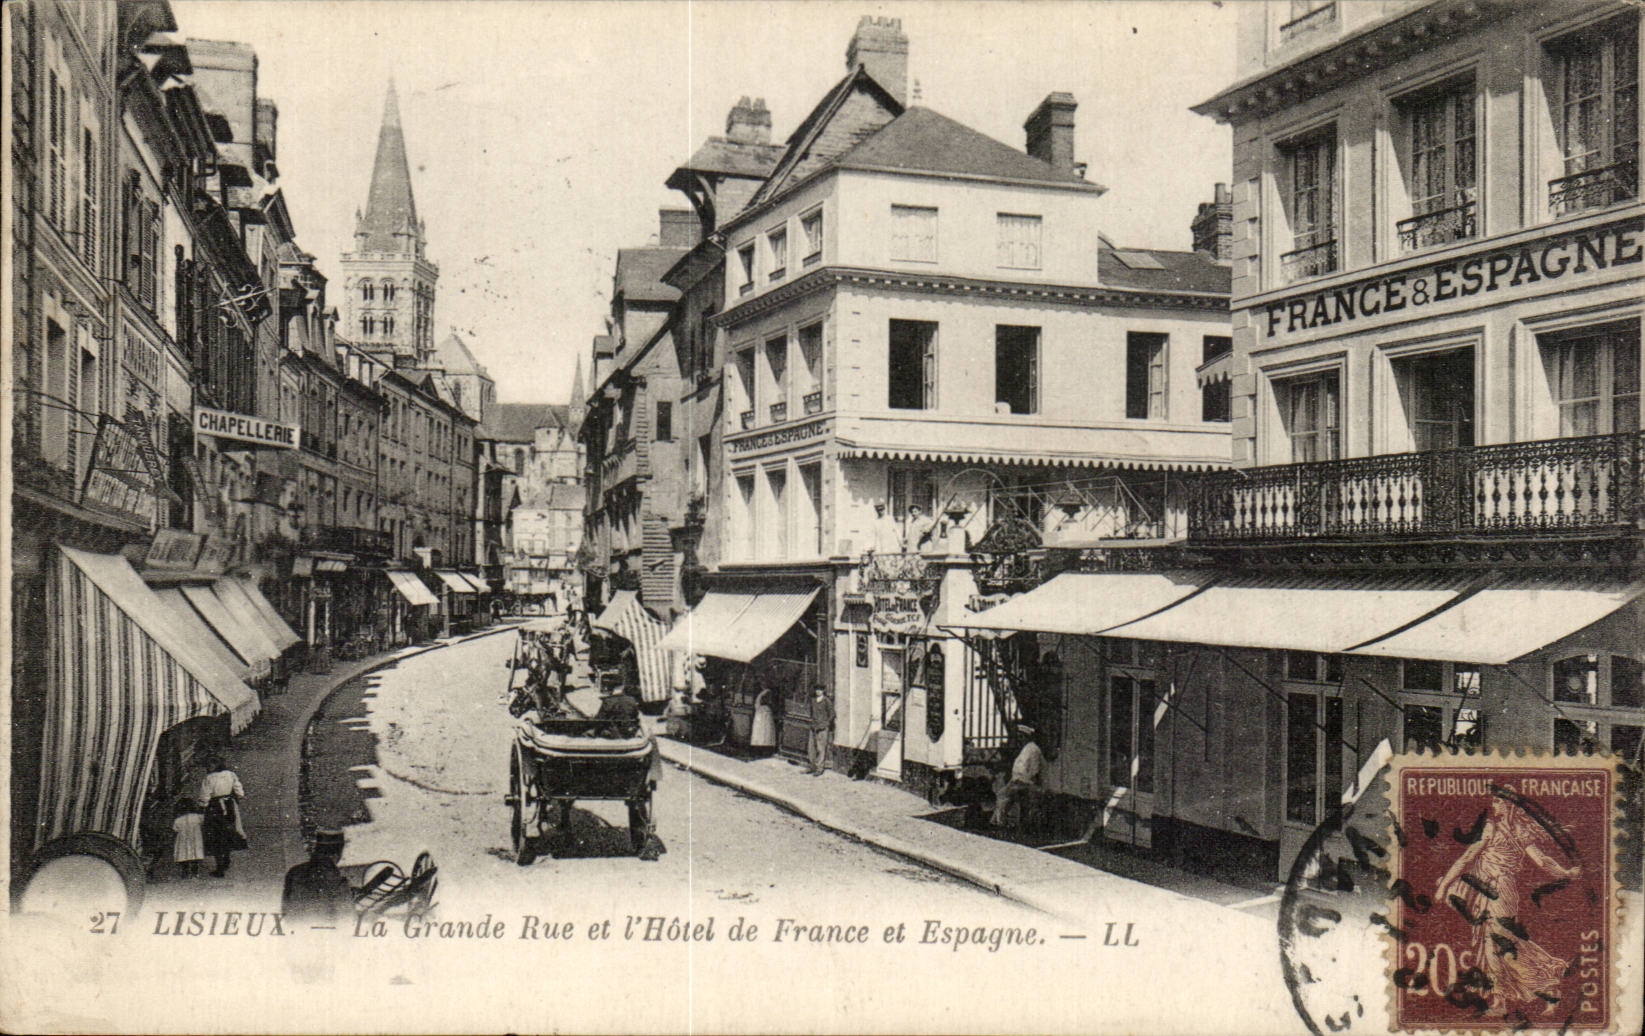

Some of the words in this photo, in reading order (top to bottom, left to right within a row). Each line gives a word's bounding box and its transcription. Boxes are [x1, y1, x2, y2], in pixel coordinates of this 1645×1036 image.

[199, 411, 296, 445] CHAPELLERIE
[1521, 778, 1601, 798] FRANÇAISE
[1580, 929, 1599, 1013] POSTES
